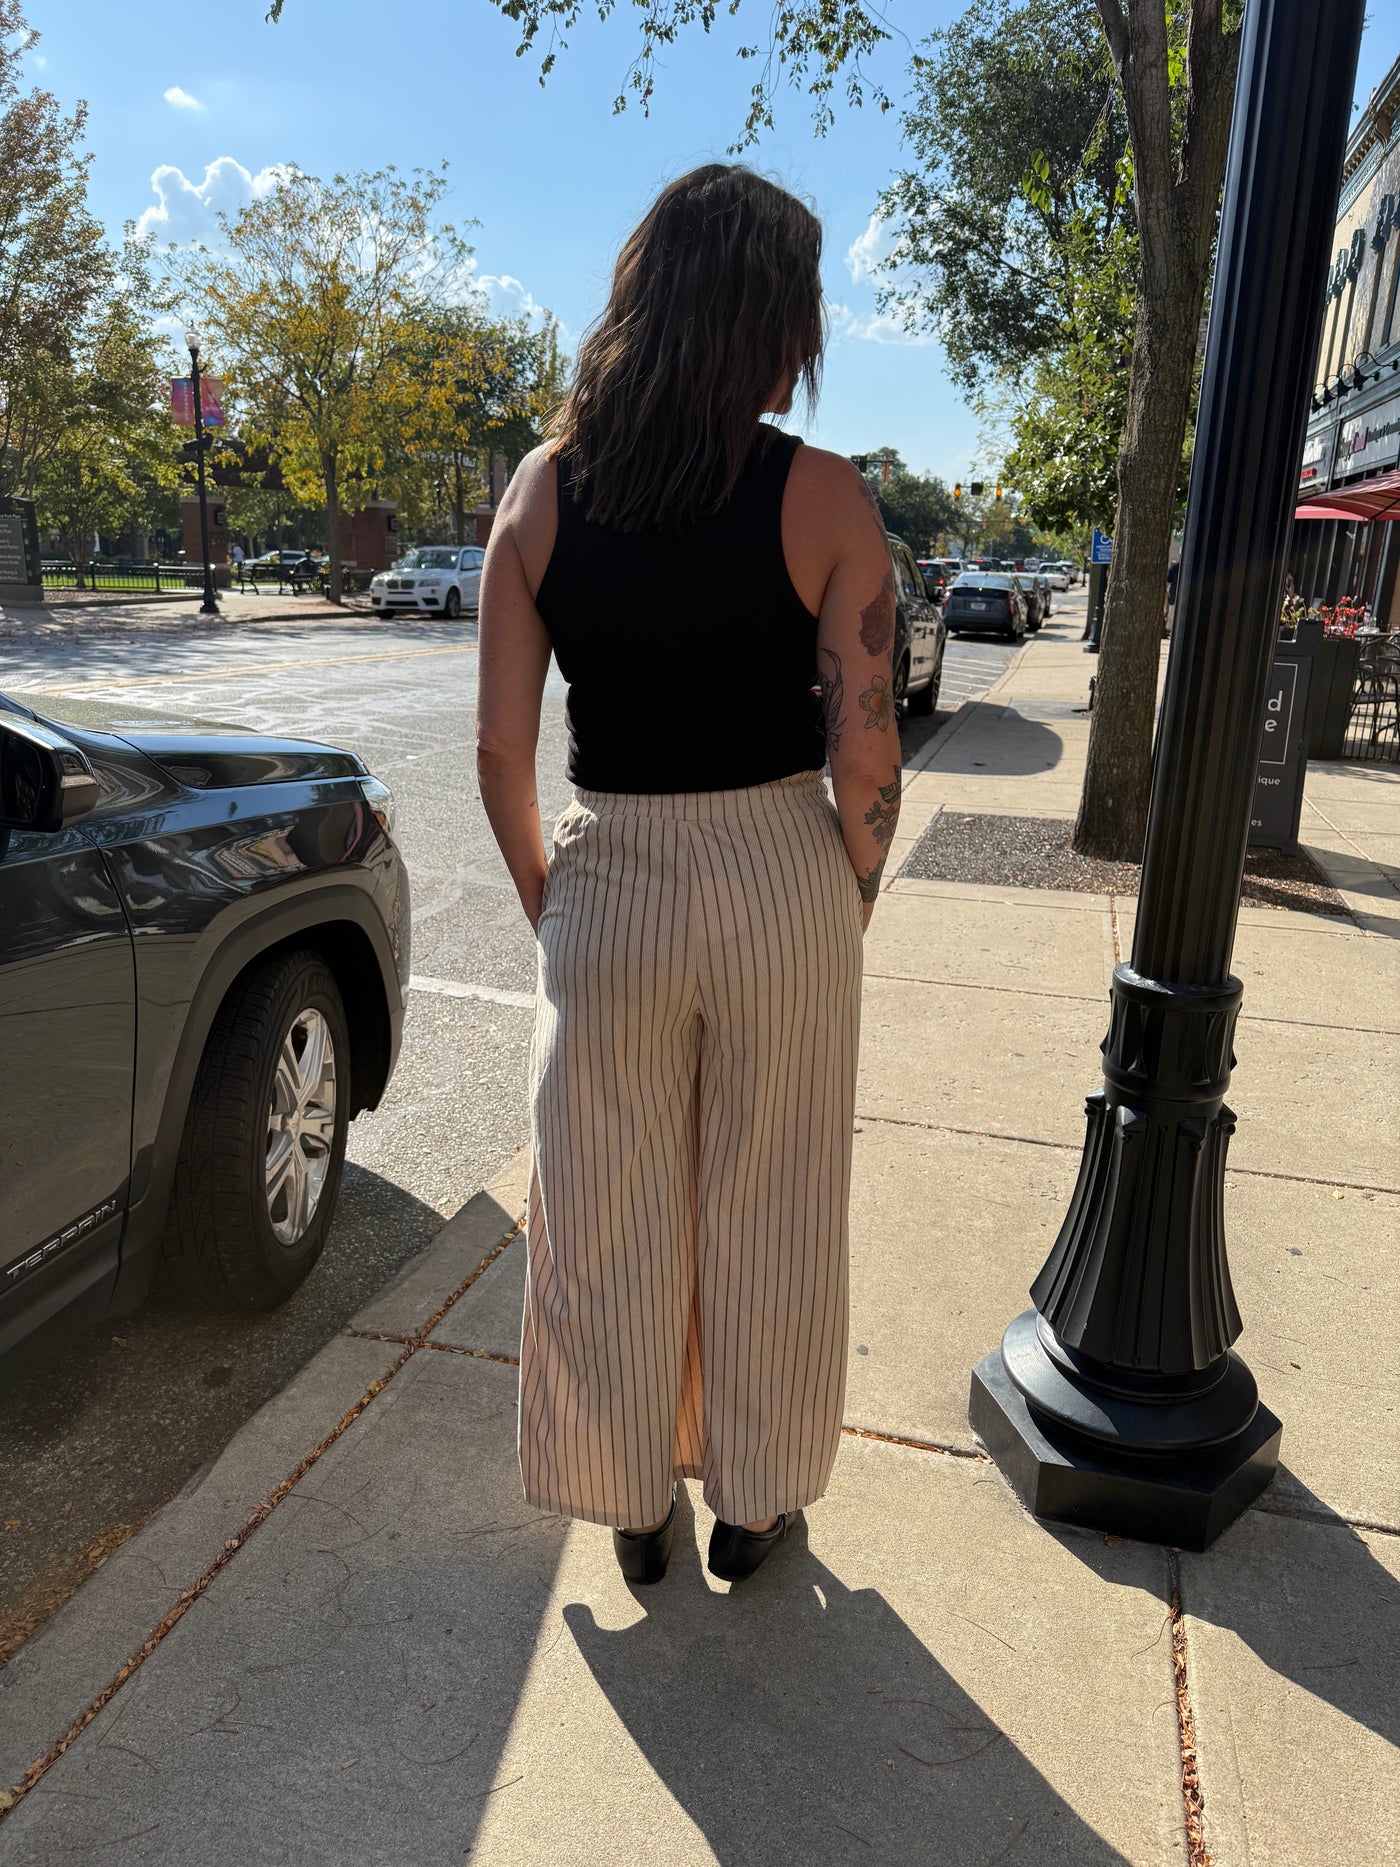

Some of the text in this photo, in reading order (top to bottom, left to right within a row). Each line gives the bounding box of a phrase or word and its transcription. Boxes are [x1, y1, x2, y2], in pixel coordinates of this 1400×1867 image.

[1267, 690, 1283, 712] d
[1265, 719, 1278, 732] e
[1257, 775, 1281, 786] ique
[1250, 819, 1263, 827] es
[6, 1200, 116, 1279] TERRAIN
